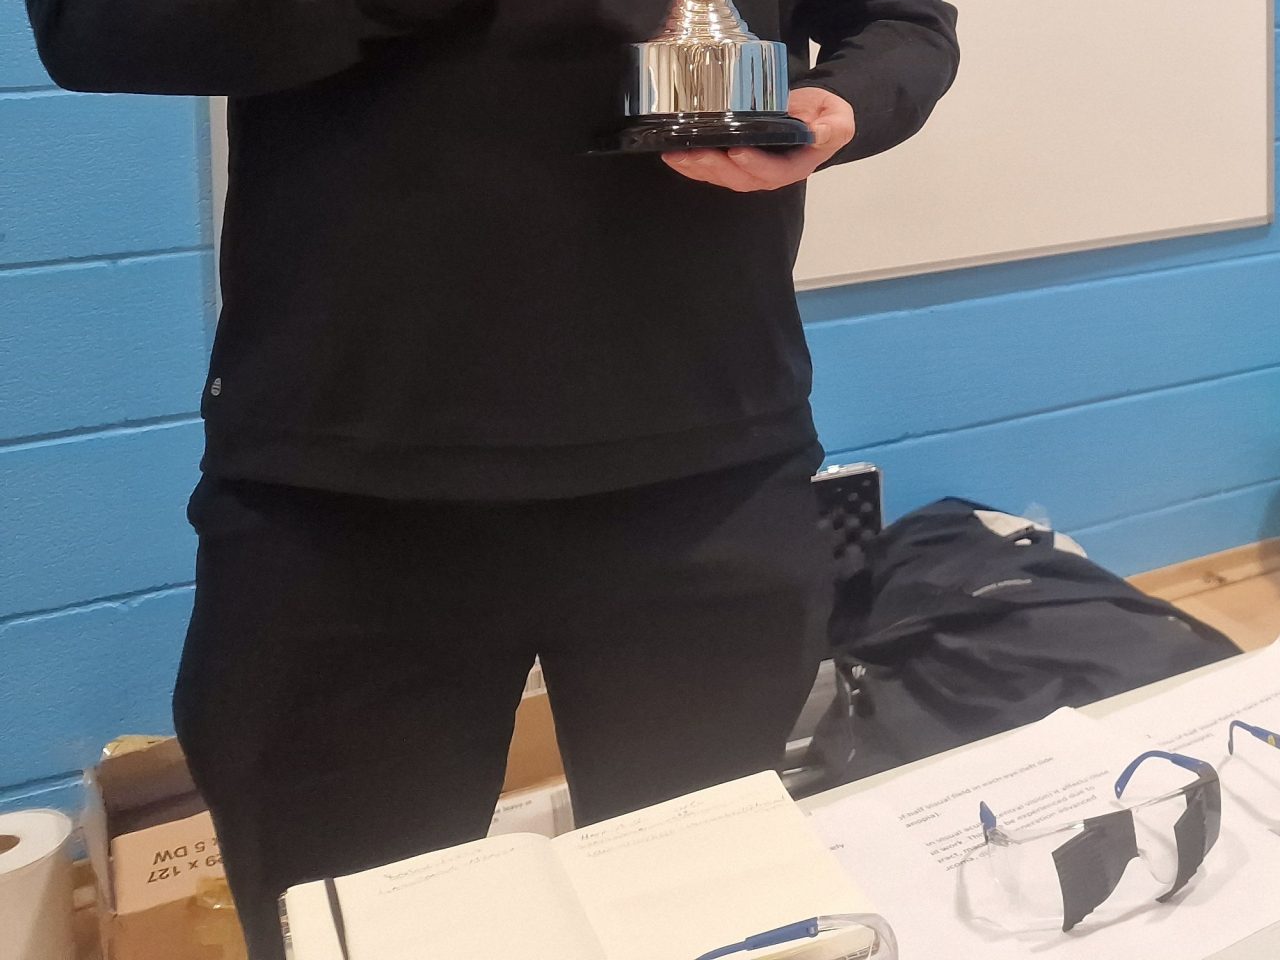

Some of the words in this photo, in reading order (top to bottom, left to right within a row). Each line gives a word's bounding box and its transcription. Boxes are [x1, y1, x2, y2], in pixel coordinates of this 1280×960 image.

[195, 841, 205, 853] 5
[153, 845, 188, 865] DW
[188, 859, 198, 870] x
[147, 866, 181, 883] 127
